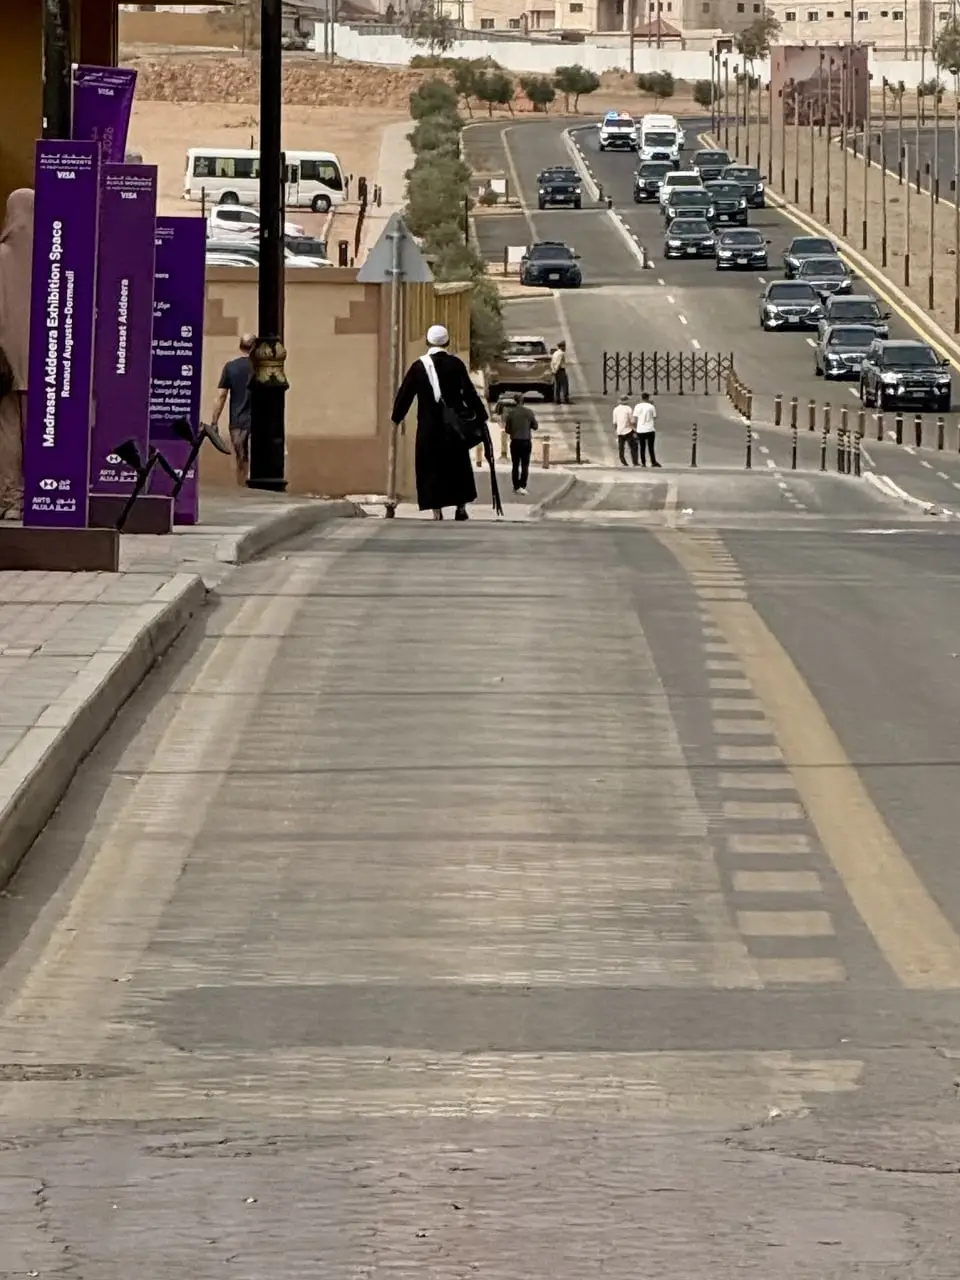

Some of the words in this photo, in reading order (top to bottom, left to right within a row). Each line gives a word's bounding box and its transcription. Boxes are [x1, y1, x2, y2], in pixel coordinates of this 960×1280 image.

[98, 88, 114, 96] VISA
[56, 171, 76, 179] VISA
[49, 220, 63, 260] Space
[47, 263, 61, 328] Exhibition
[63, 270, 74, 358] Auguste-Dormeuil
[118, 278, 128, 324] Addeera
[45, 330, 58, 384] Addeera
[116, 325, 127, 374] Madrasat
[61, 360, 71, 398] Renaud
[42, 386, 56, 448] Madrasat
